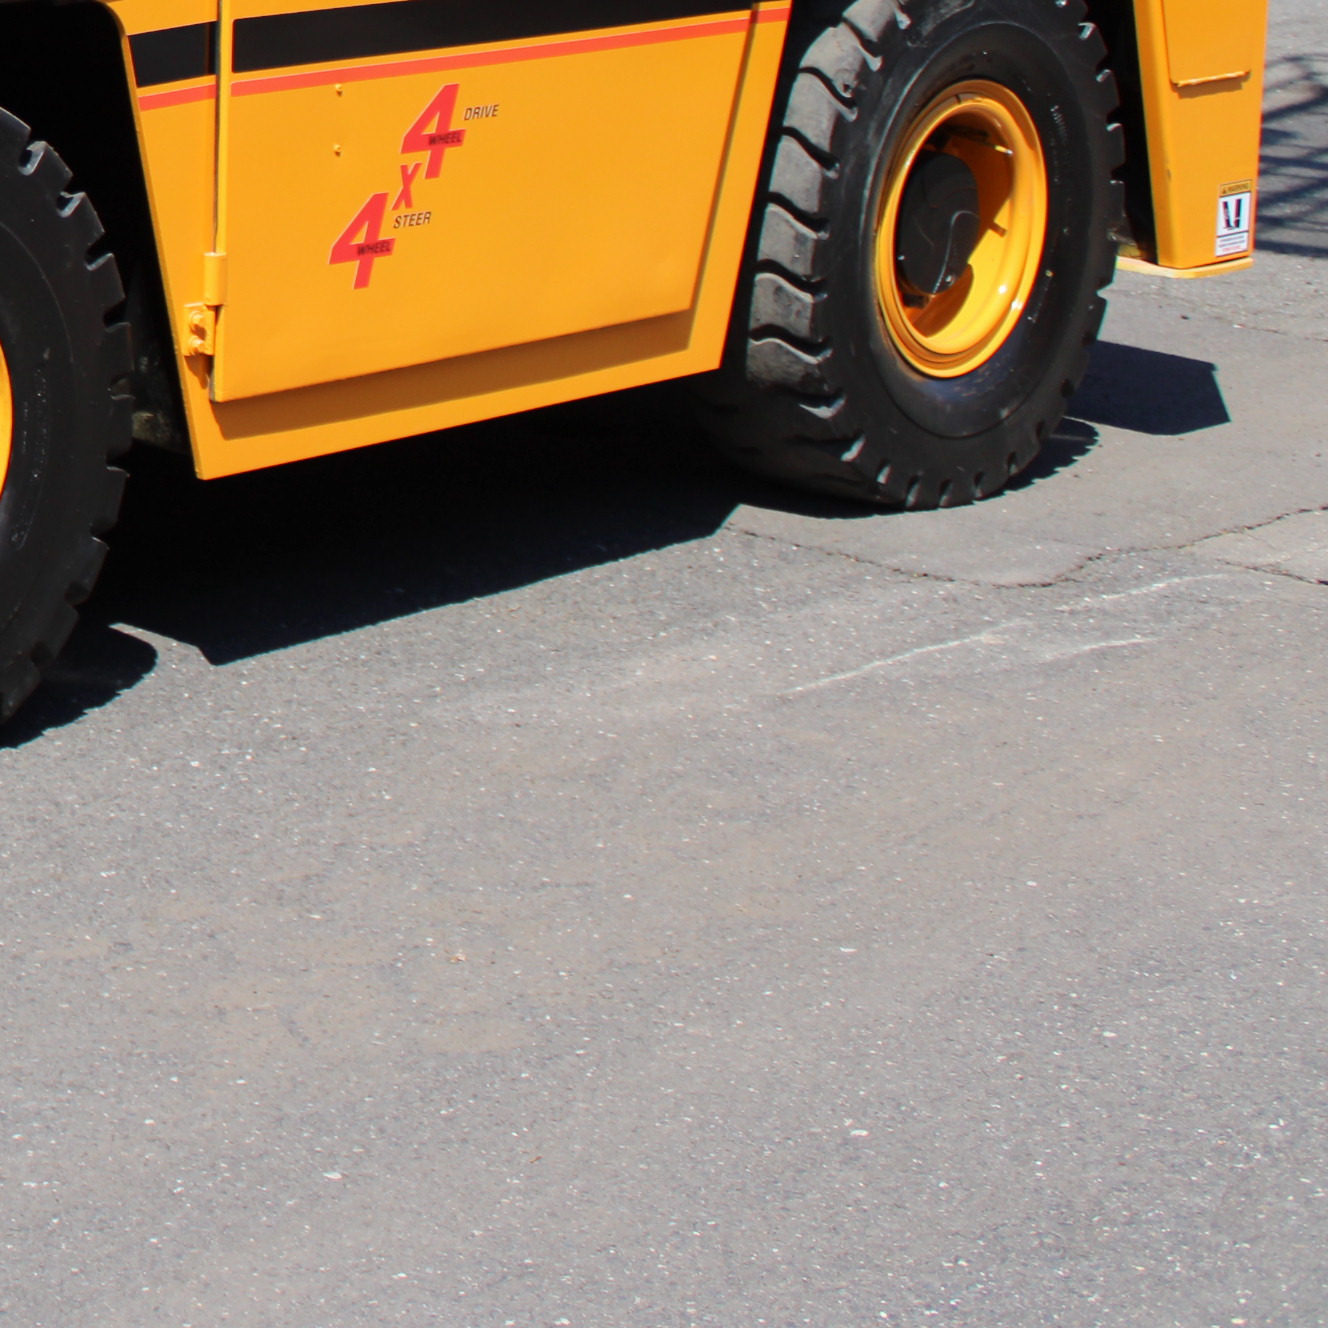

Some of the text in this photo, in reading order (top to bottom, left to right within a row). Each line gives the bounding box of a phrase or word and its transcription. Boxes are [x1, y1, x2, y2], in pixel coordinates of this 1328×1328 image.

[400, 83, 500, 180] 4 DRIVE
[428, 130, 462, 146] WHEEL
[391, 162, 423, 211] X
[328, 192, 432, 290] 4 STEER
[357, 241, 392, 256] WHEEL
